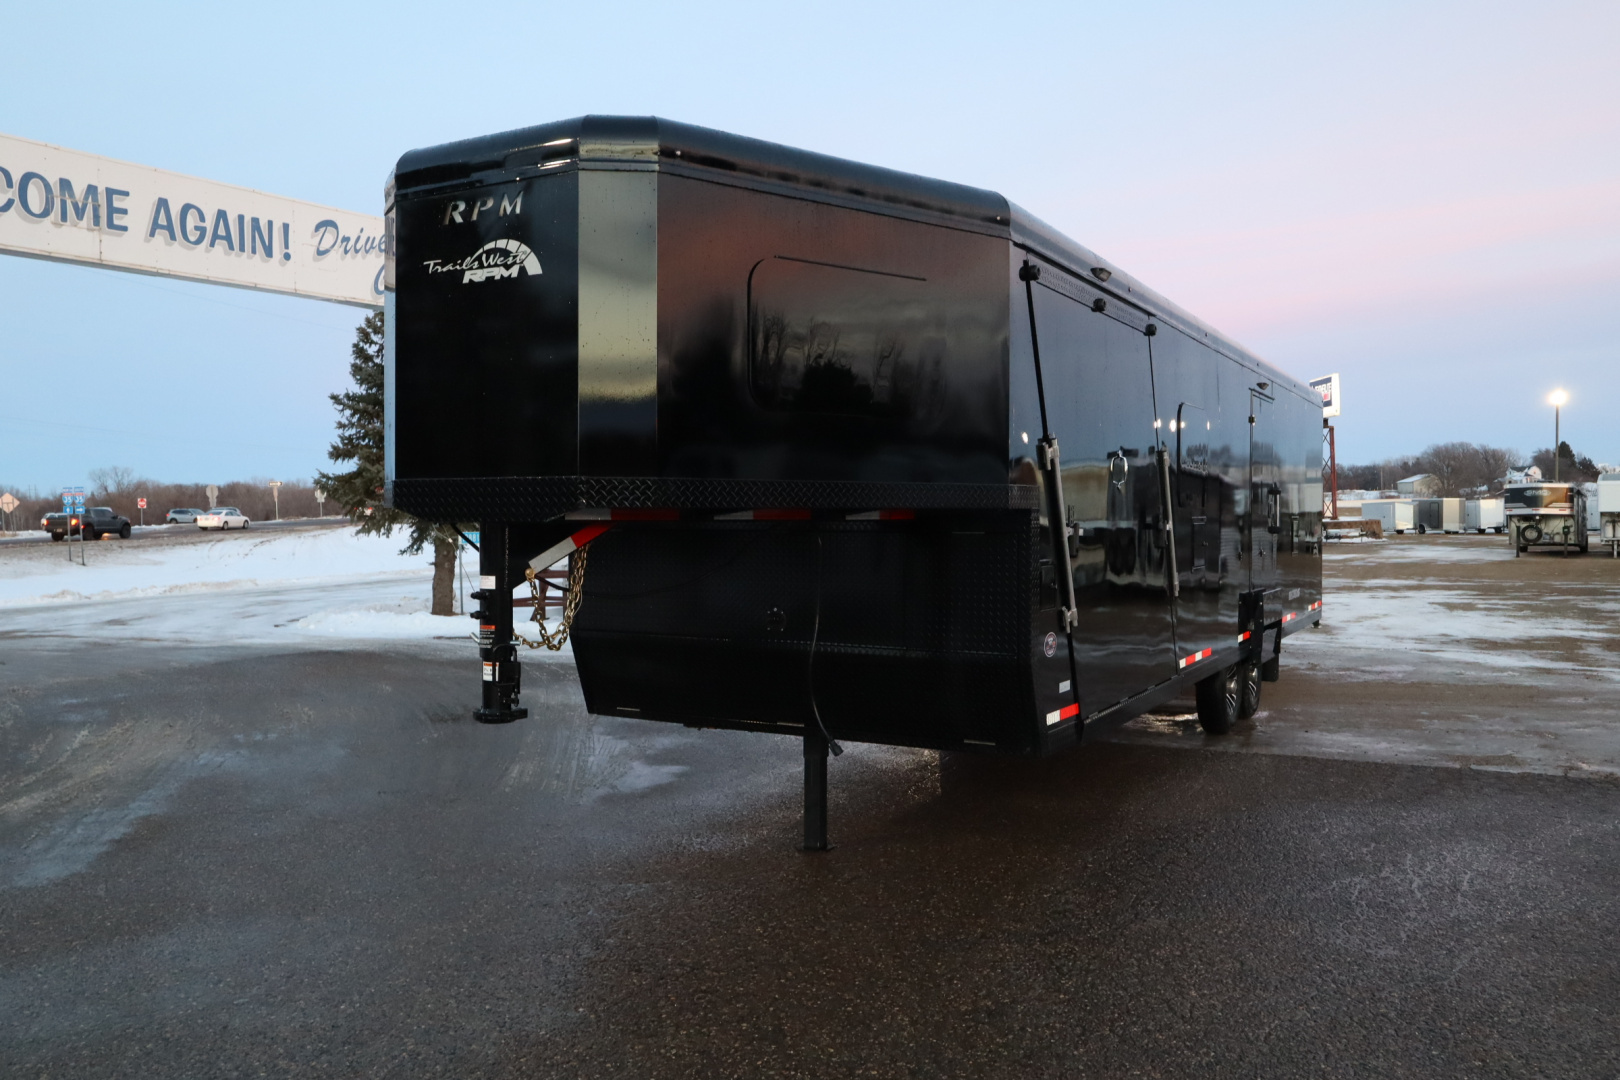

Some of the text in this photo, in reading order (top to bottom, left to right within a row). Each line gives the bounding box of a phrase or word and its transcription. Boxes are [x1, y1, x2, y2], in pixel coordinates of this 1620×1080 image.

[443, 190, 524, 226] RPM
[149, 196, 292, 262] AGAIN!
[313, 219, 386, 257] Drive
[423, 255, 480, 275] Trails
[462, 264, 520, 284] RPM
